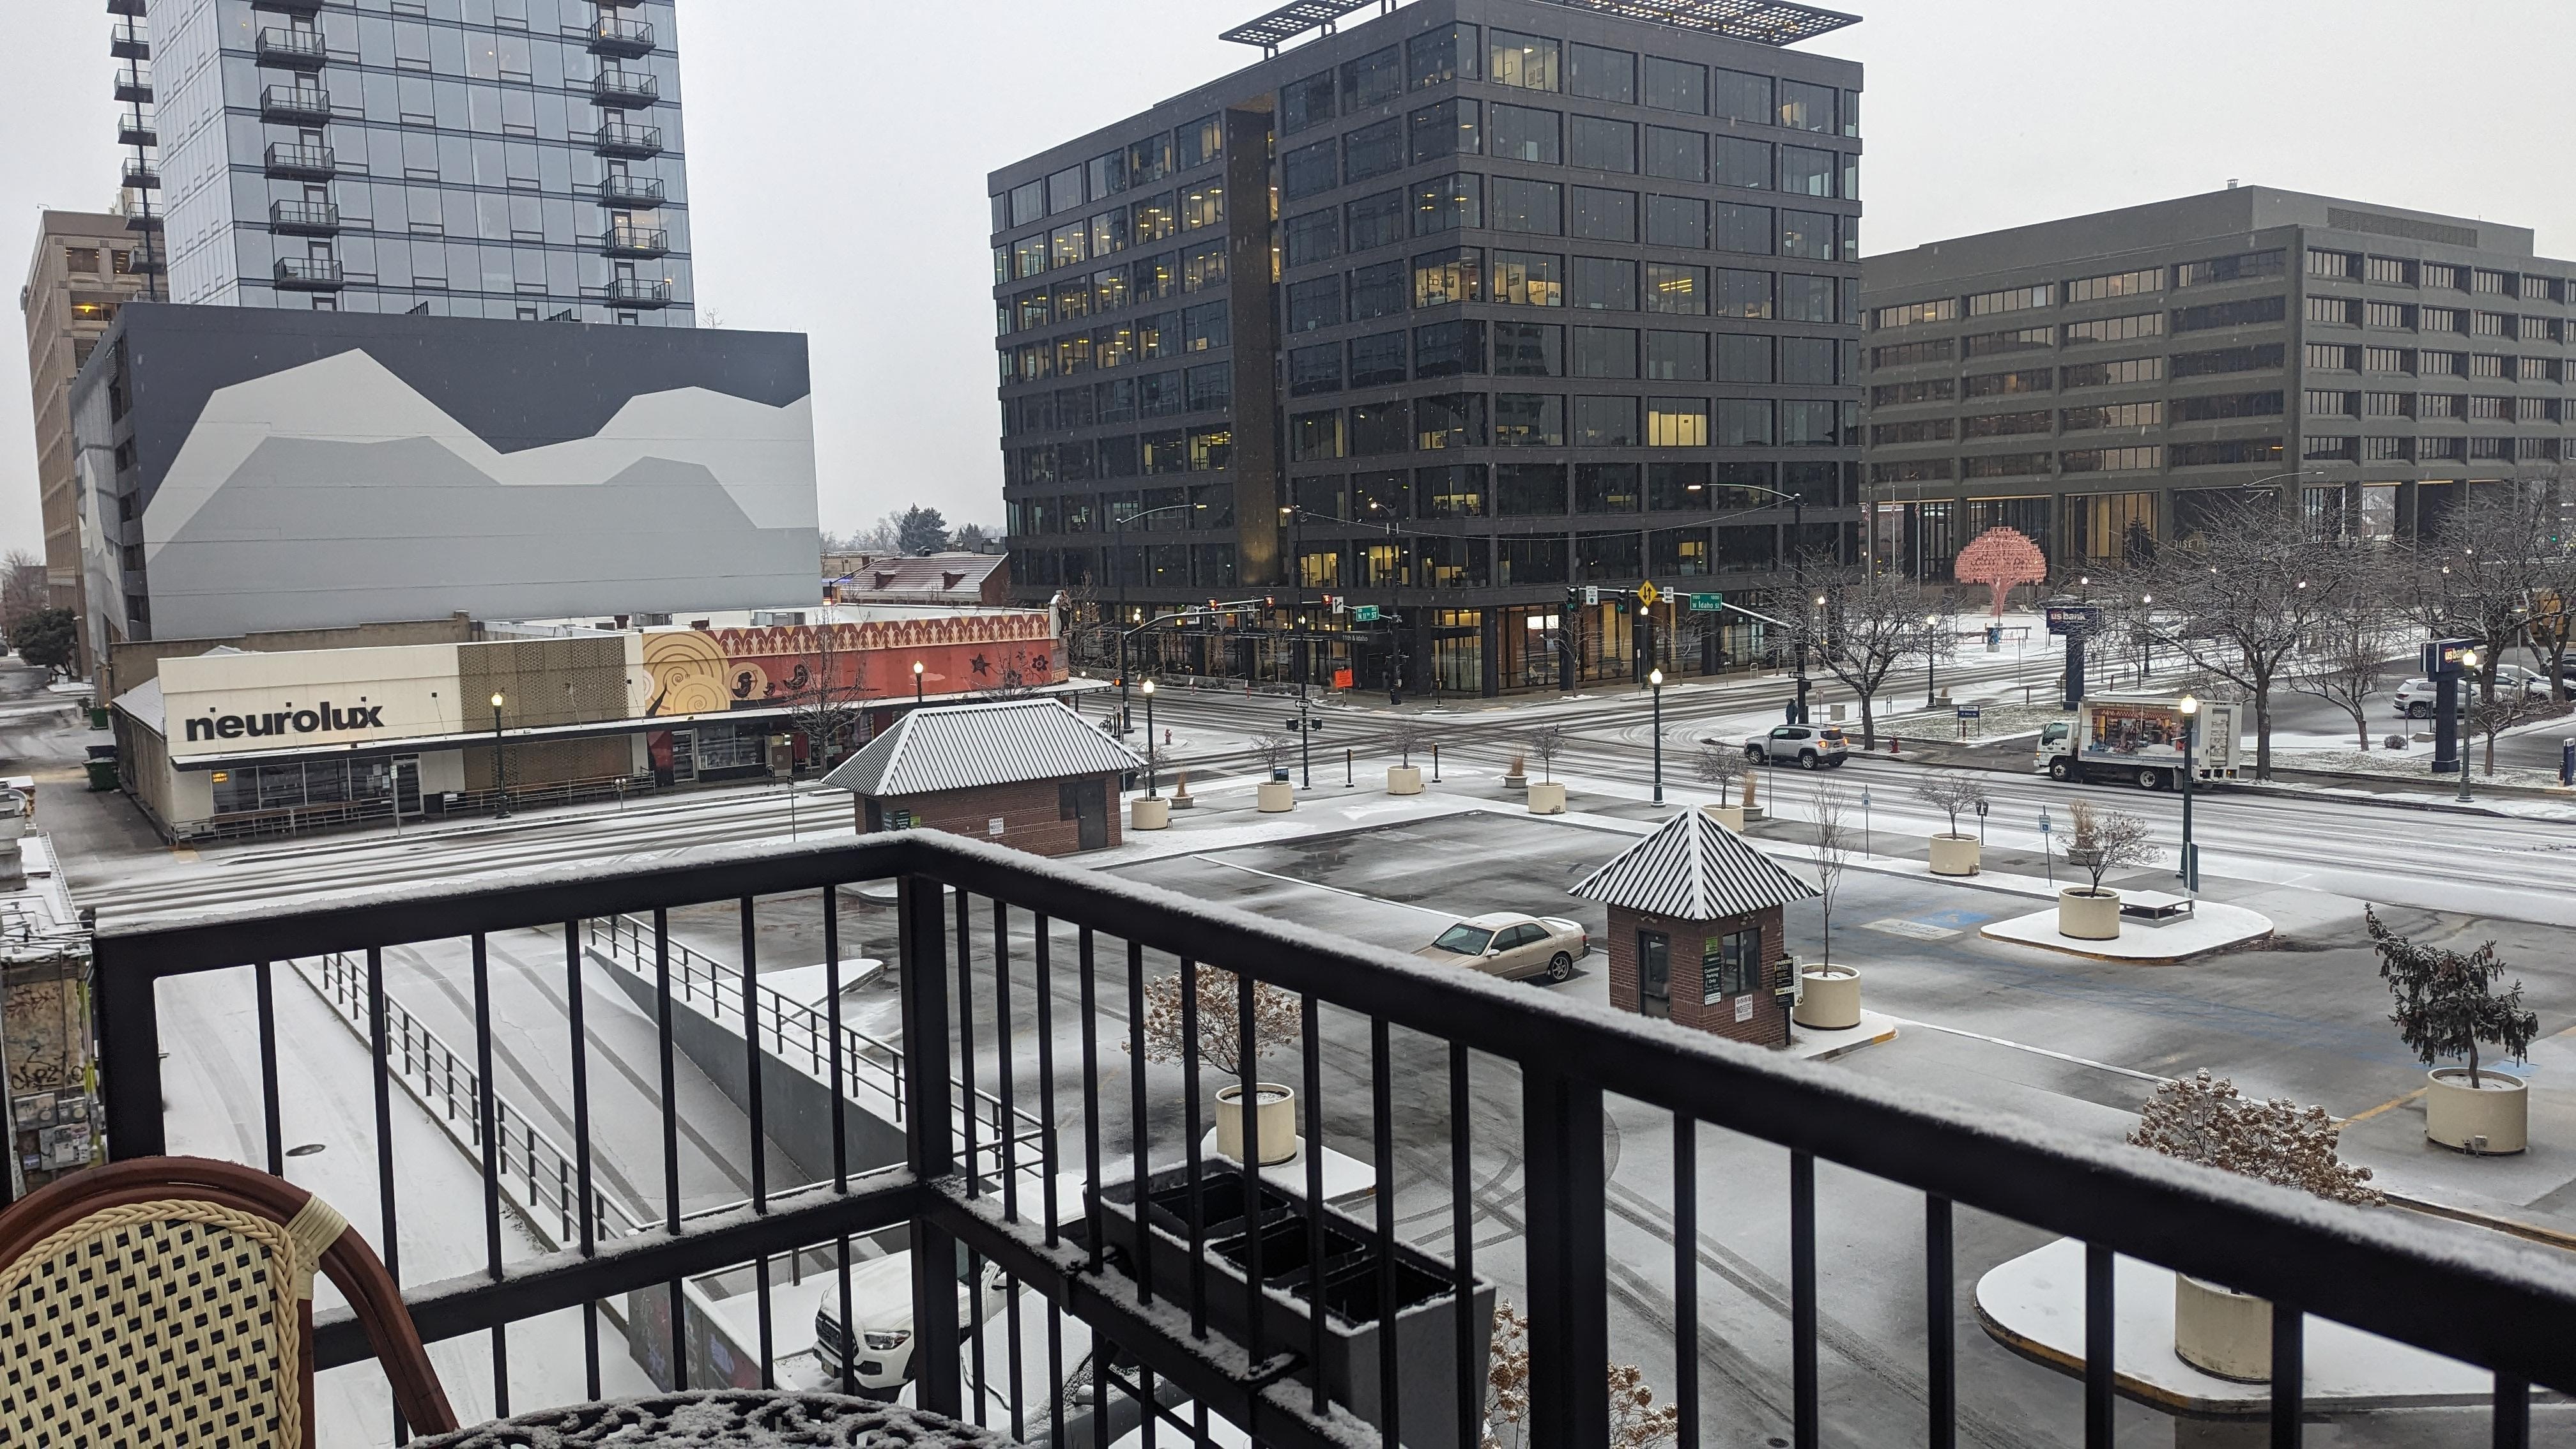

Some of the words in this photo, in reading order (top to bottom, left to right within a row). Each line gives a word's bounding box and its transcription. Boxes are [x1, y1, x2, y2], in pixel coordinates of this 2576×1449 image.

[1698, 601, 1713, 609] Idaho
[185, 702, 385, 742] neurolux
[1736, 1006, 1743, 1015] NO
